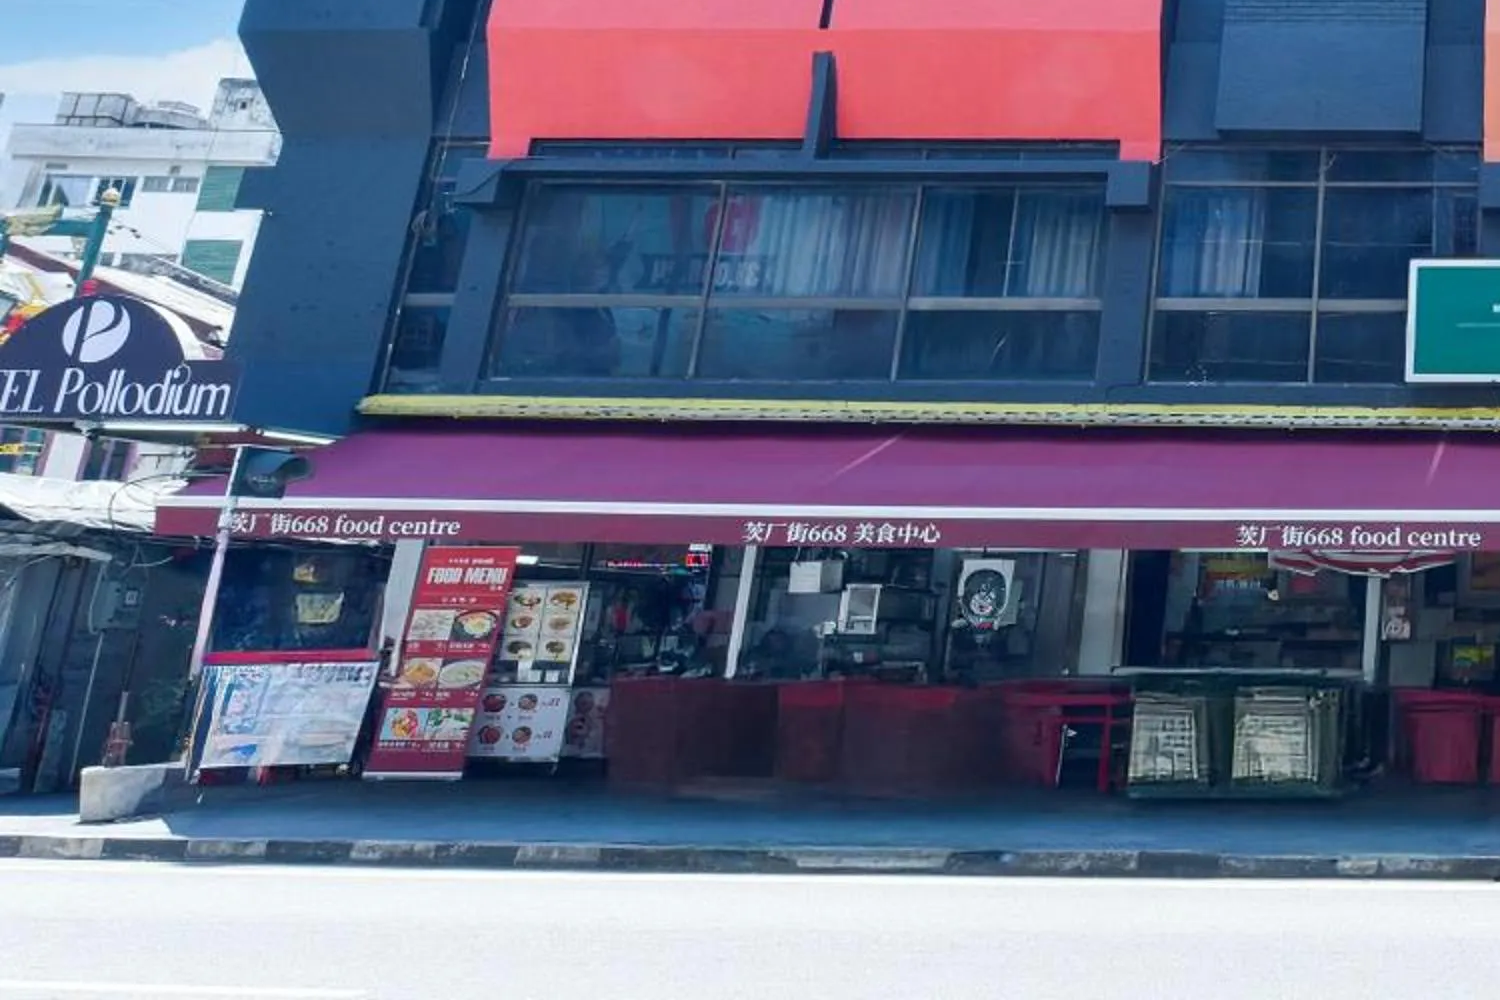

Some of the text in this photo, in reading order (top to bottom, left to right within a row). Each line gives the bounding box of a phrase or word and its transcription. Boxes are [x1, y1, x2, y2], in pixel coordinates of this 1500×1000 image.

[334, 513, 384, 536] food
[388, 517, 461, 536] centre
[853, 522, 942, 545] 美食中心
[1350, 525, 1401, 547] food
[1407, 529, 1482, 547] centre
[426, 567, 509, 585] FOOD MENU
